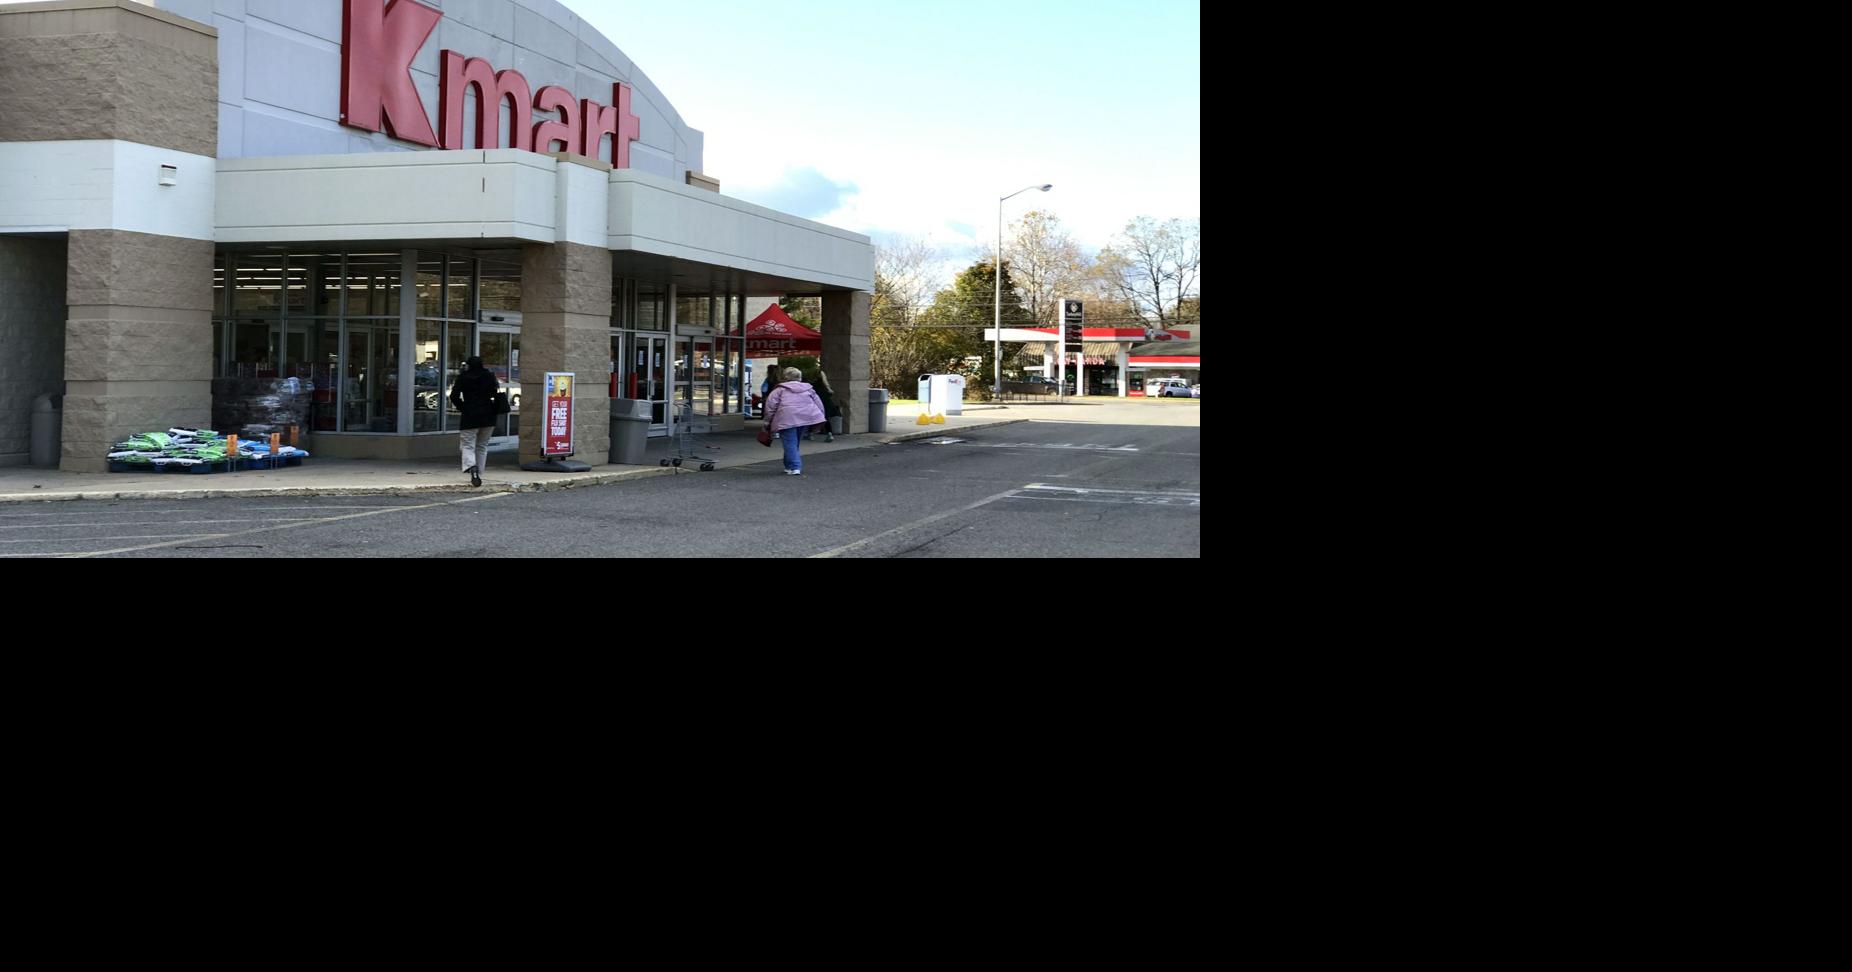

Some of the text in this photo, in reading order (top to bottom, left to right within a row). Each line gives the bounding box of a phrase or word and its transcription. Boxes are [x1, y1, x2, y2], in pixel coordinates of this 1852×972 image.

[339, 0, 640, 169] Kmart
[745, 337, 797, 349] mart
[551, 407, 567, 420] FREE
[551, 426, 567, 436] TODAY
